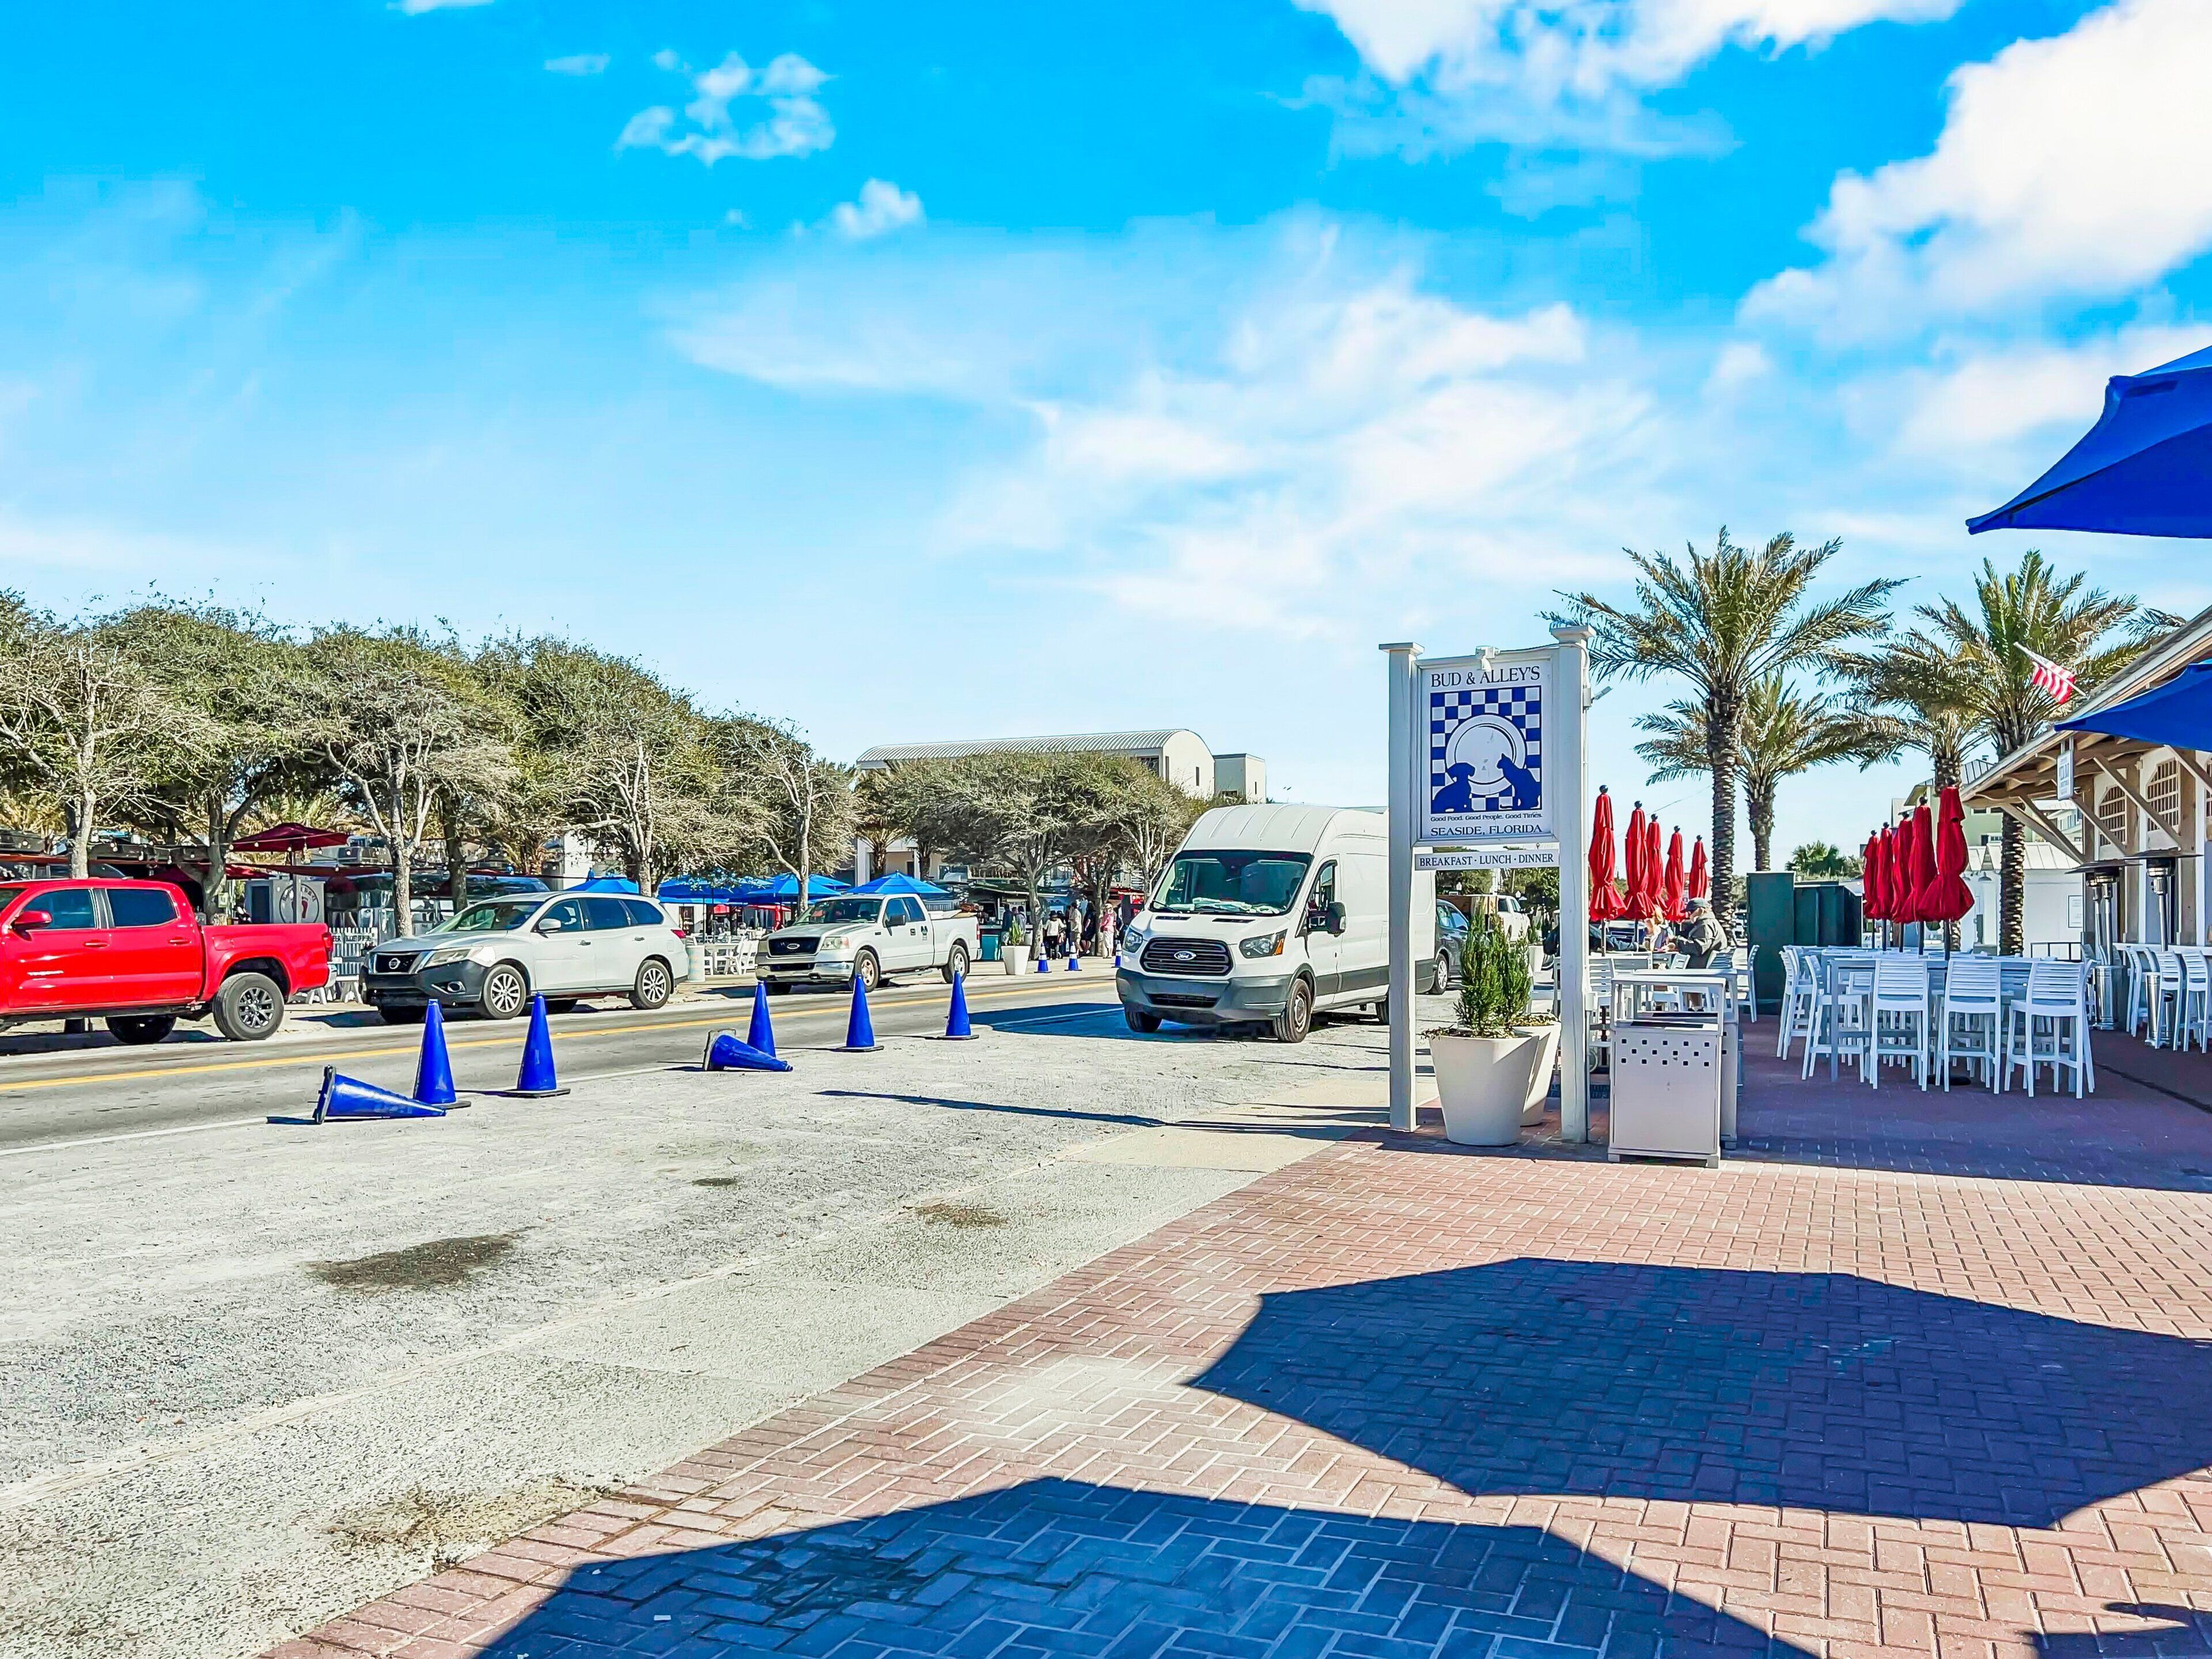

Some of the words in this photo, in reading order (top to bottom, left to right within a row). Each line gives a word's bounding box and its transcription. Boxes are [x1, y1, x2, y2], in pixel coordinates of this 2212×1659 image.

[1431, 672, 1461, 687] BUD
[1466, 672, 1475, 685] &
[1479, 666, 1540, 684] ALLEY'S
[1430, 826, 1485, 836] SEASIDE,
[1489, 824, 1542, 834] FLORIDA
[1419, 856, 1473, 866] BREAKFAST
[1479, 855, 1512, 864] LUNCH
[1518, 854, 1554, 863] DINNER
